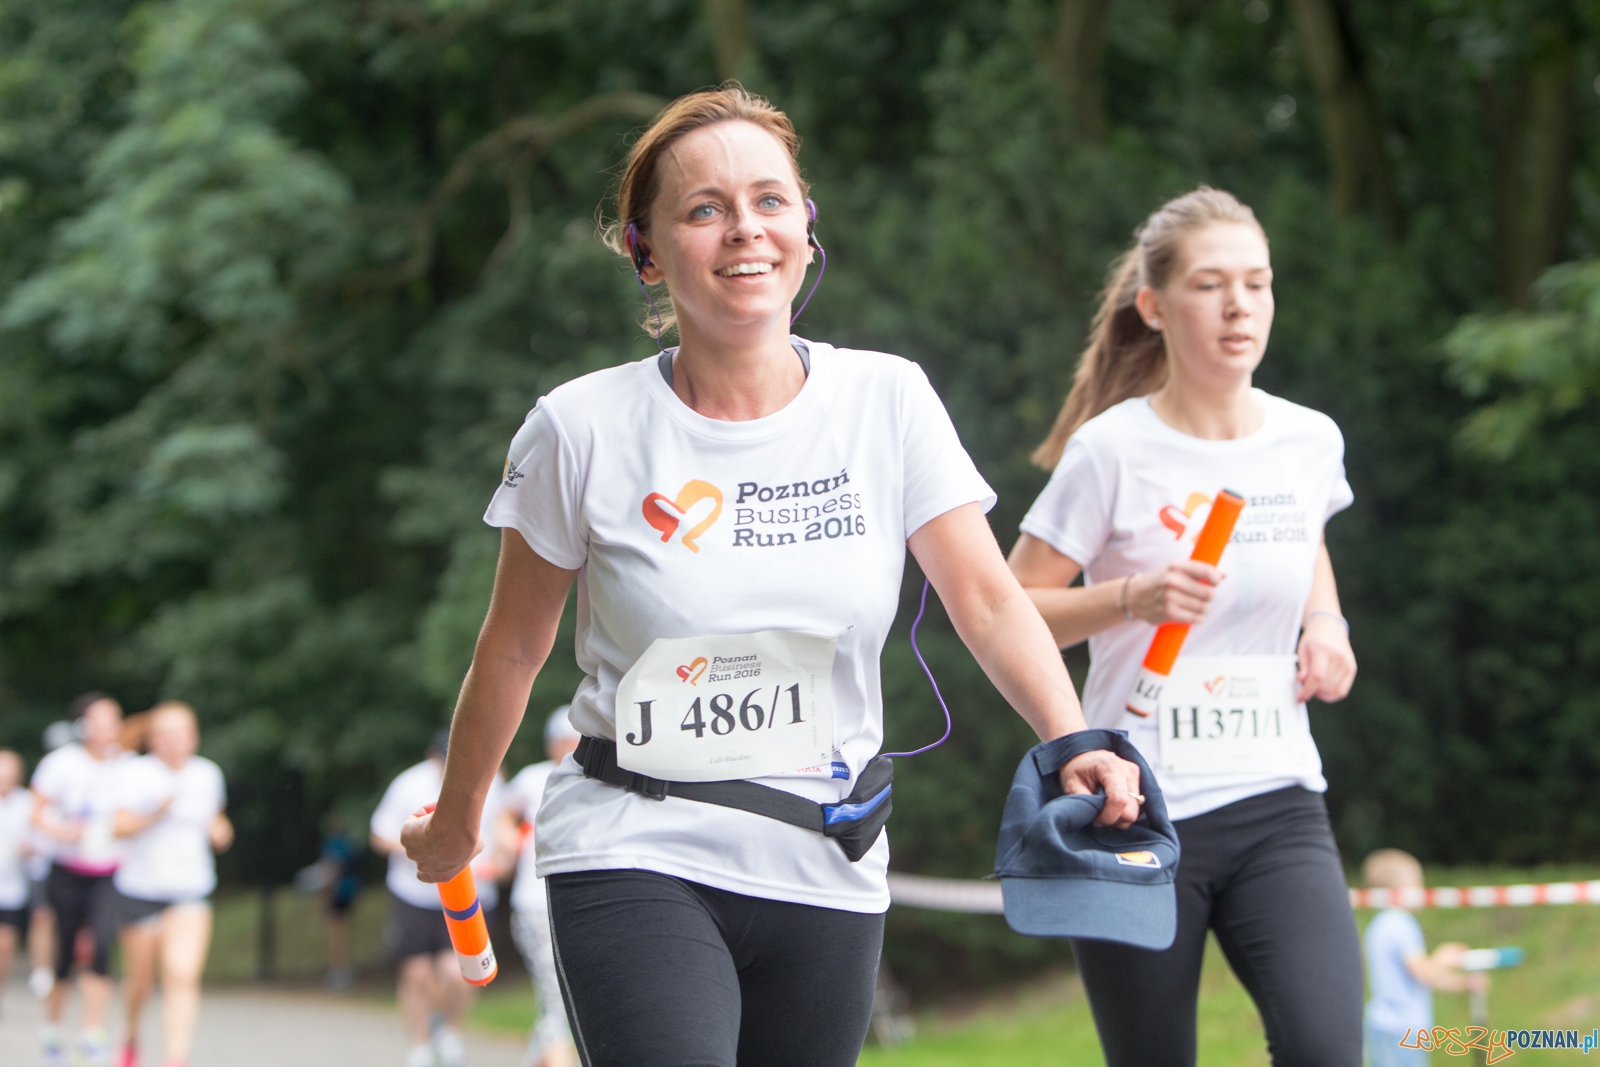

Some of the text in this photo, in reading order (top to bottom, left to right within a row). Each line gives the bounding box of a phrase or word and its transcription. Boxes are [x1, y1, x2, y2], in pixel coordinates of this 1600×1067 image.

[735, 467, 850, 504] Poznań
[734, 493, 861, 525] Business
[732, 514, 866, 547] Run 2016
[710, 662, 762, 673] Business
[712, 653, 758, 664] Poznań
[708, 668, 761, 682] Run 2016
[625, 699, 657, 746] J
[680, 682, 806, 739] 486/1
